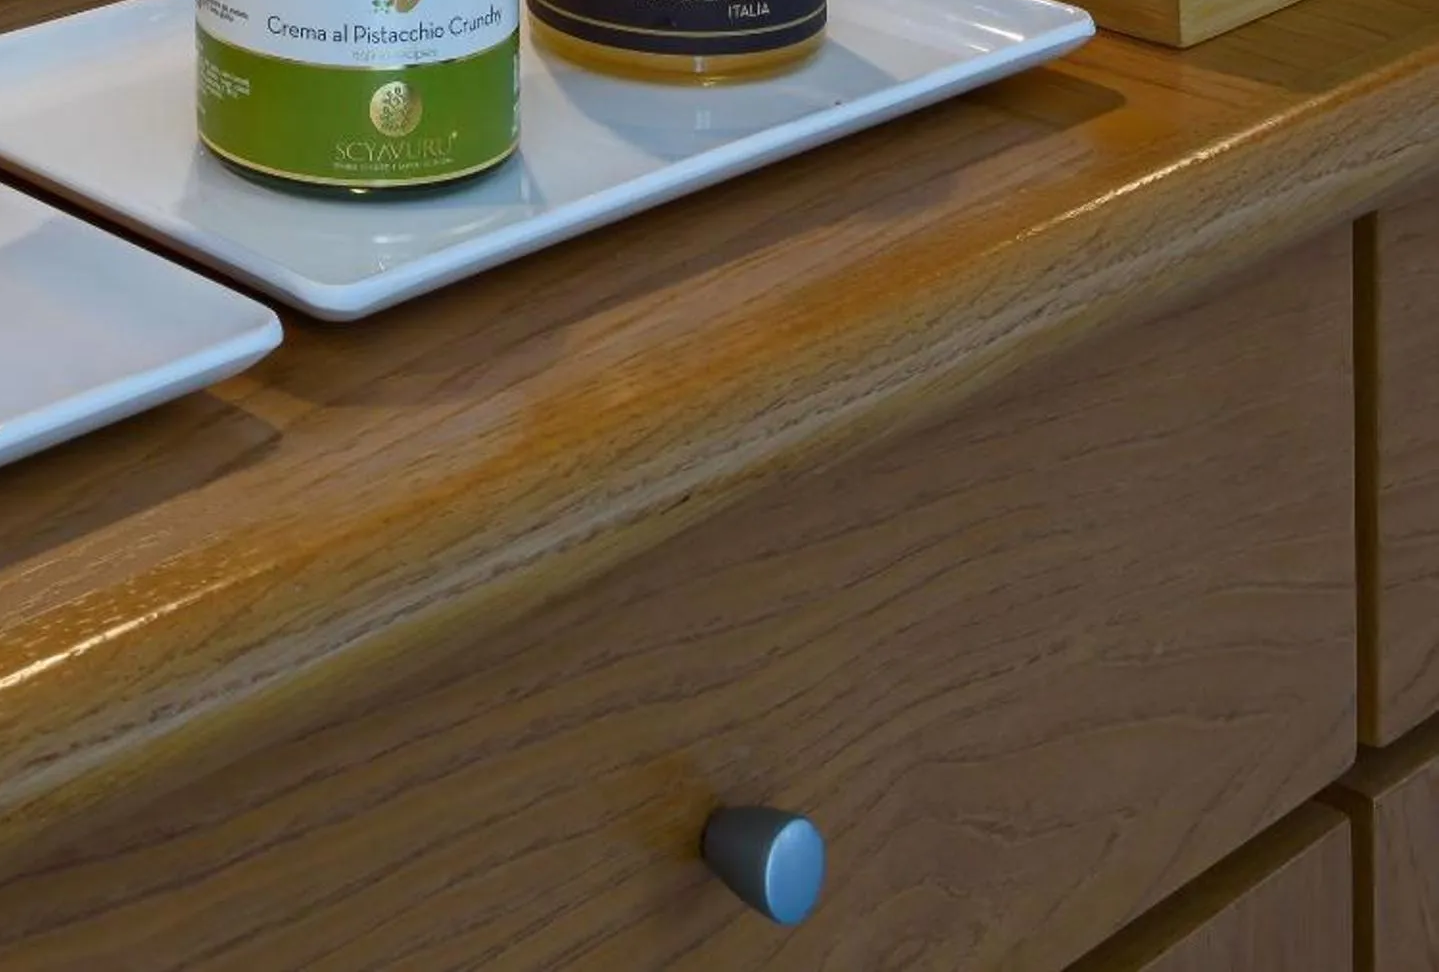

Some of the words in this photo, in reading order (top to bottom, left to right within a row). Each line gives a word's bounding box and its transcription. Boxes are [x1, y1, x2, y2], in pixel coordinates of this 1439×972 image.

[727, 2, 771, 20] ITALIA
[266, 14, 327, 42] Crema
[332, 23, 348, 44] al
[353, 21, 445, 45] Pistacchio
[334, 133, 453, 163] SCYAVURU
